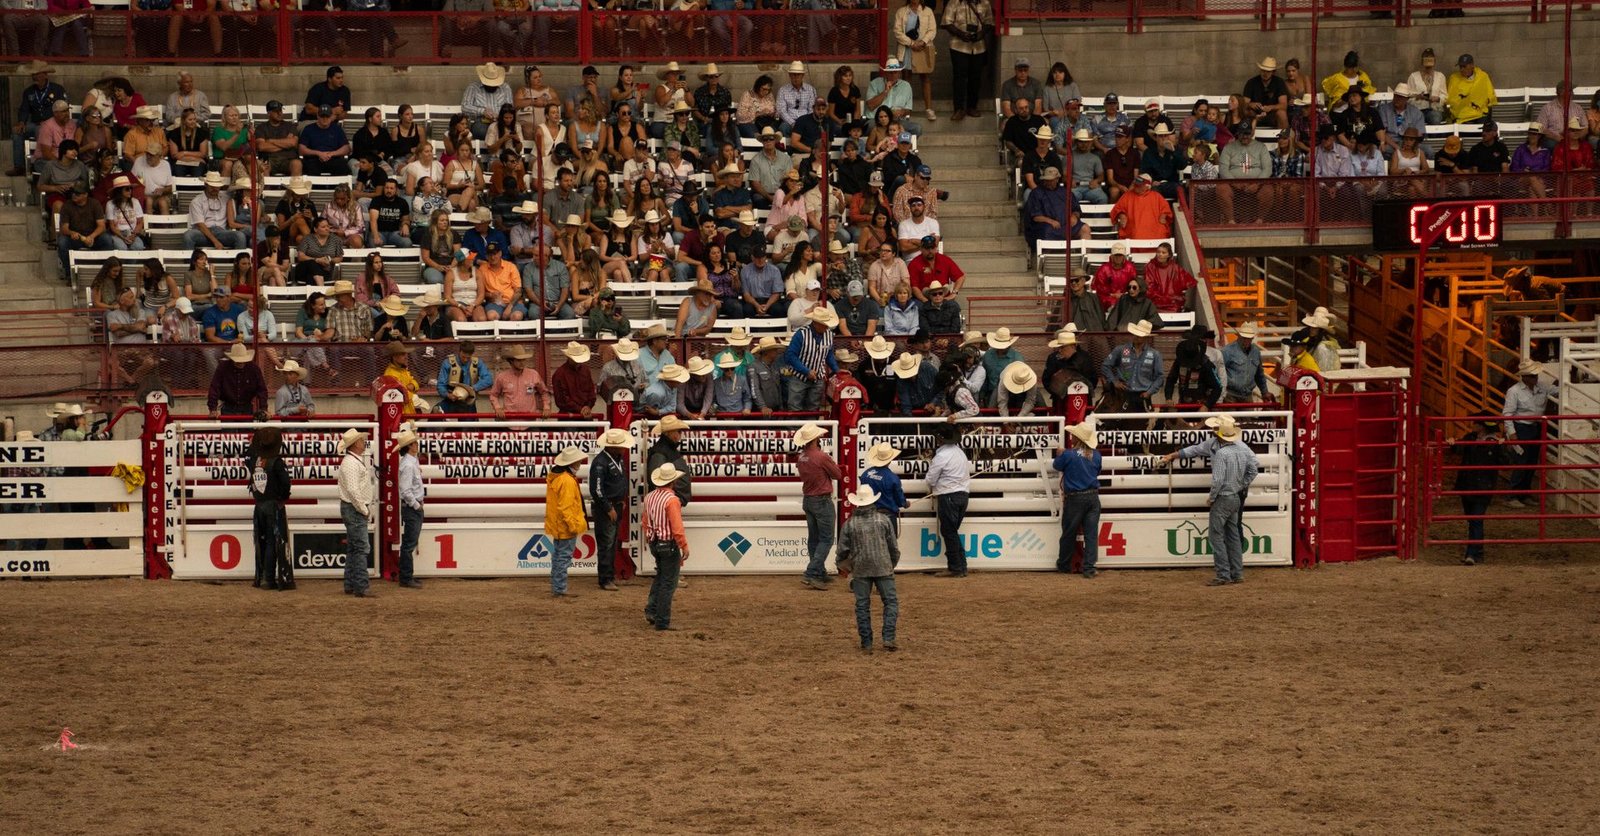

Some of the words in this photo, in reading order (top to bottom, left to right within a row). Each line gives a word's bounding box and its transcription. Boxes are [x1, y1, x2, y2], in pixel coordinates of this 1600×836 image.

[872, 436, 934, 448] CHEYENN
[957, 436, 1012, 448] ONTIER
[1097, 432, 1167, 444] CHEYENNE
[1172, 431, 1217, 444] FRONT
[420, 440, 482, 453] HEYENNE
[487, 440, 552, 453] FRONTIER
[720, 439, 784, 452] FRONTIER
[0, 447, 44, 462] NE
[205, 467, 248, 479] "DADD
[493, 466, 509, 478] OF
[724, 464, 741, 476] OF
[772, 464, 798, 476] ALL
[898, 461, 930, 473] "DAD
[0, 483, 46, 498] ER
[165, 430, 174, 562] CHEYENNE
[757, 538, 800, 548] Cheyenne
[920, 528, 1003, 558] bue
[1098, 522, 1126, 556] 4
[1164, 528, 1272, 556] Unn
[210, 534, 242, 570] 0
[435, 534, 457, 569] 1
[765, 548, 799, 557] Medical
[299, 550, 346, 567] devo
[0, 560, 50, 572] .com
